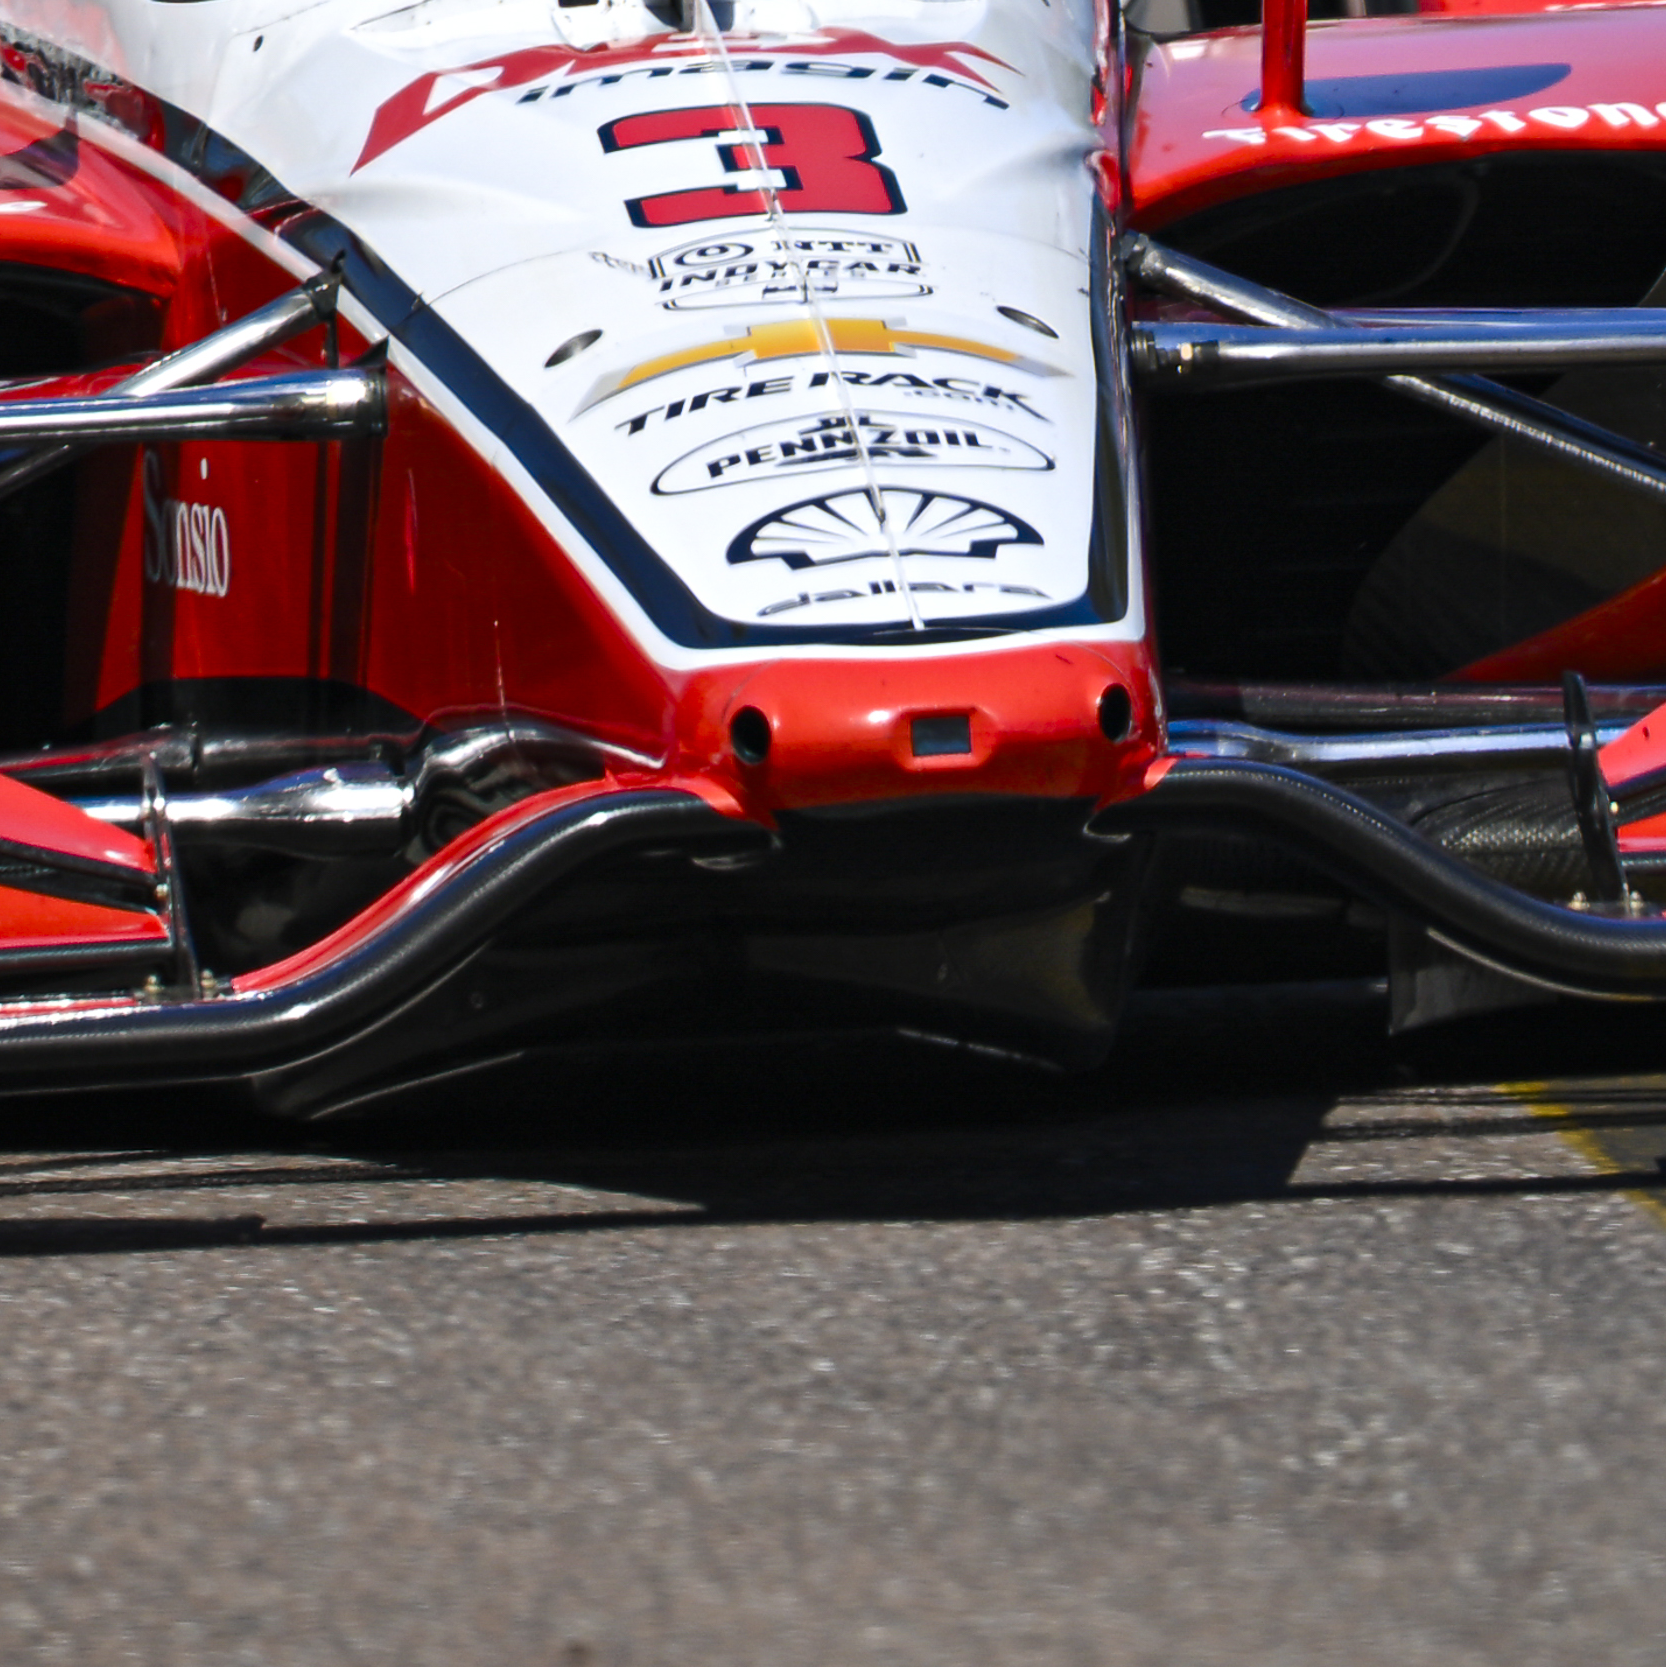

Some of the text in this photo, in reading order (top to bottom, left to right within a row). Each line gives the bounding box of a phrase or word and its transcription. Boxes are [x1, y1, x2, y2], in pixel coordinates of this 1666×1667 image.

[596, 101, 909, 228] 3
[613, 370, 1055, 436] TIRE RACK
[705, 430, 994, 479] PENNZOIL
